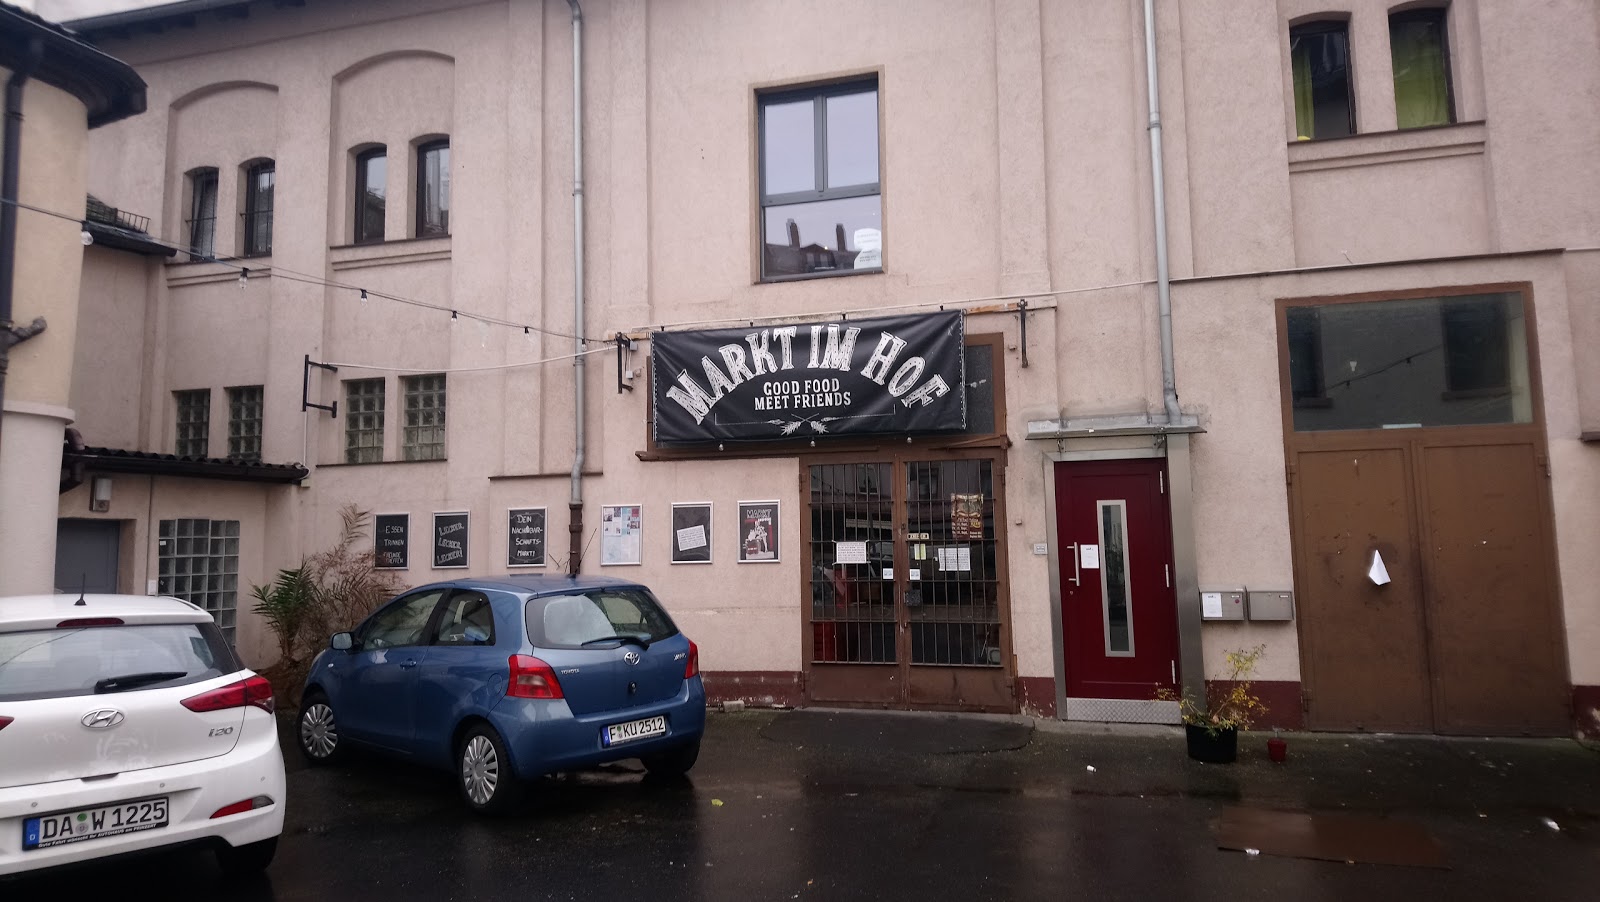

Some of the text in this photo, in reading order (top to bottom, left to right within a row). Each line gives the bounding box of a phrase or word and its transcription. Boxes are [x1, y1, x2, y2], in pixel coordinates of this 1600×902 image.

[666, 324, 951, 425] MARKT IM HOF
[763, 378, 840, 396] GOOD FOOD
[754, 391, 852, 411] MEET FRIENDS
[385, 525, 404, 534] ESSEN
[208, 726, 234, 737] i20
[610, 726, 616, 740] F
[622, 722, 638, 737] KU
[639, 717, 664, 734] 2512
[43, 801, 166, 839] DA W 1225
